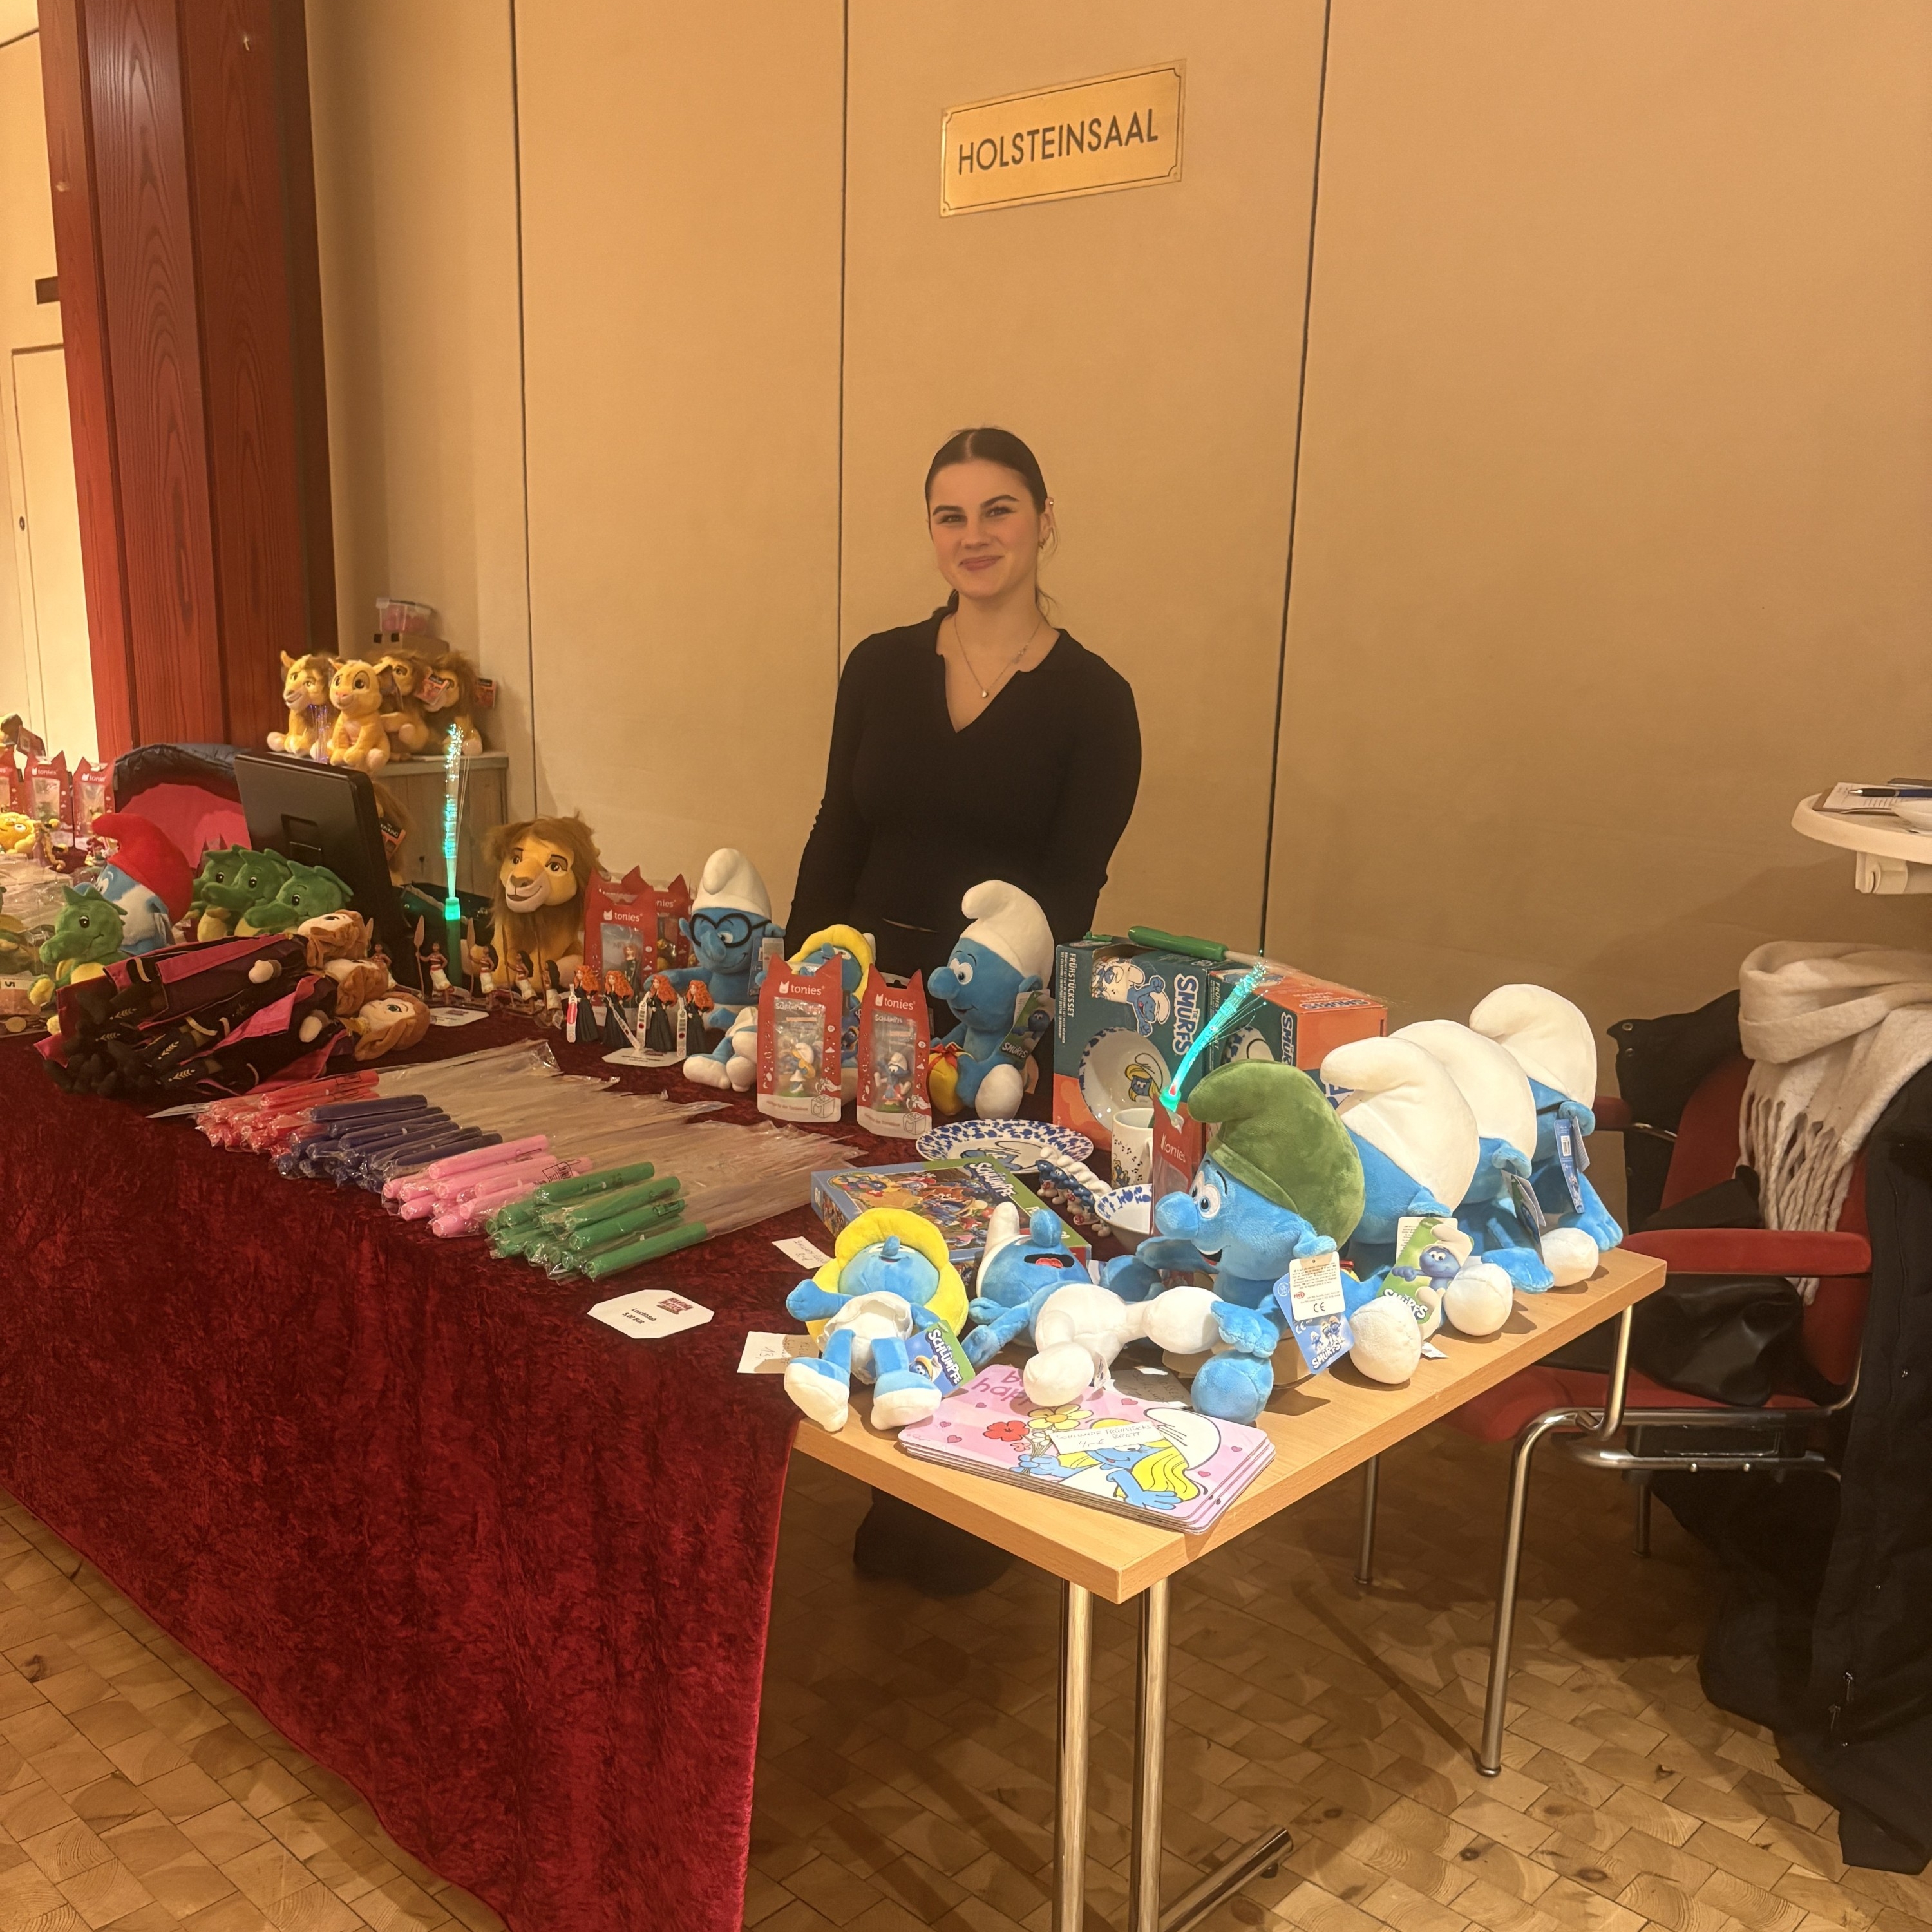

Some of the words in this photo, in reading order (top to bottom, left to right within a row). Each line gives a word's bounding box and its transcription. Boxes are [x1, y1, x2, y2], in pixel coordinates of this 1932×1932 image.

[958, 108, 1159, 175] HOLSTEINSAAL
[655, 899, 674, 908] nies
[614, 913, 640, 922] tonies
[791, 984, 822, 996] tonies
[1067, 952, 1077, 1018] FRÜHSTÜCKSSET
[884, 997, 913, 1010] tonies
[1175, 976, 1198, 1054] SMURFS
[1001, 1041, 1028, 1059] SMURFS
[1281, 1013, 1293, 1065] SMUR
[928, 1329, 963, 1385] SCHLÜMPFE
[1311, 1343, 1341, 1370] SMURFS
